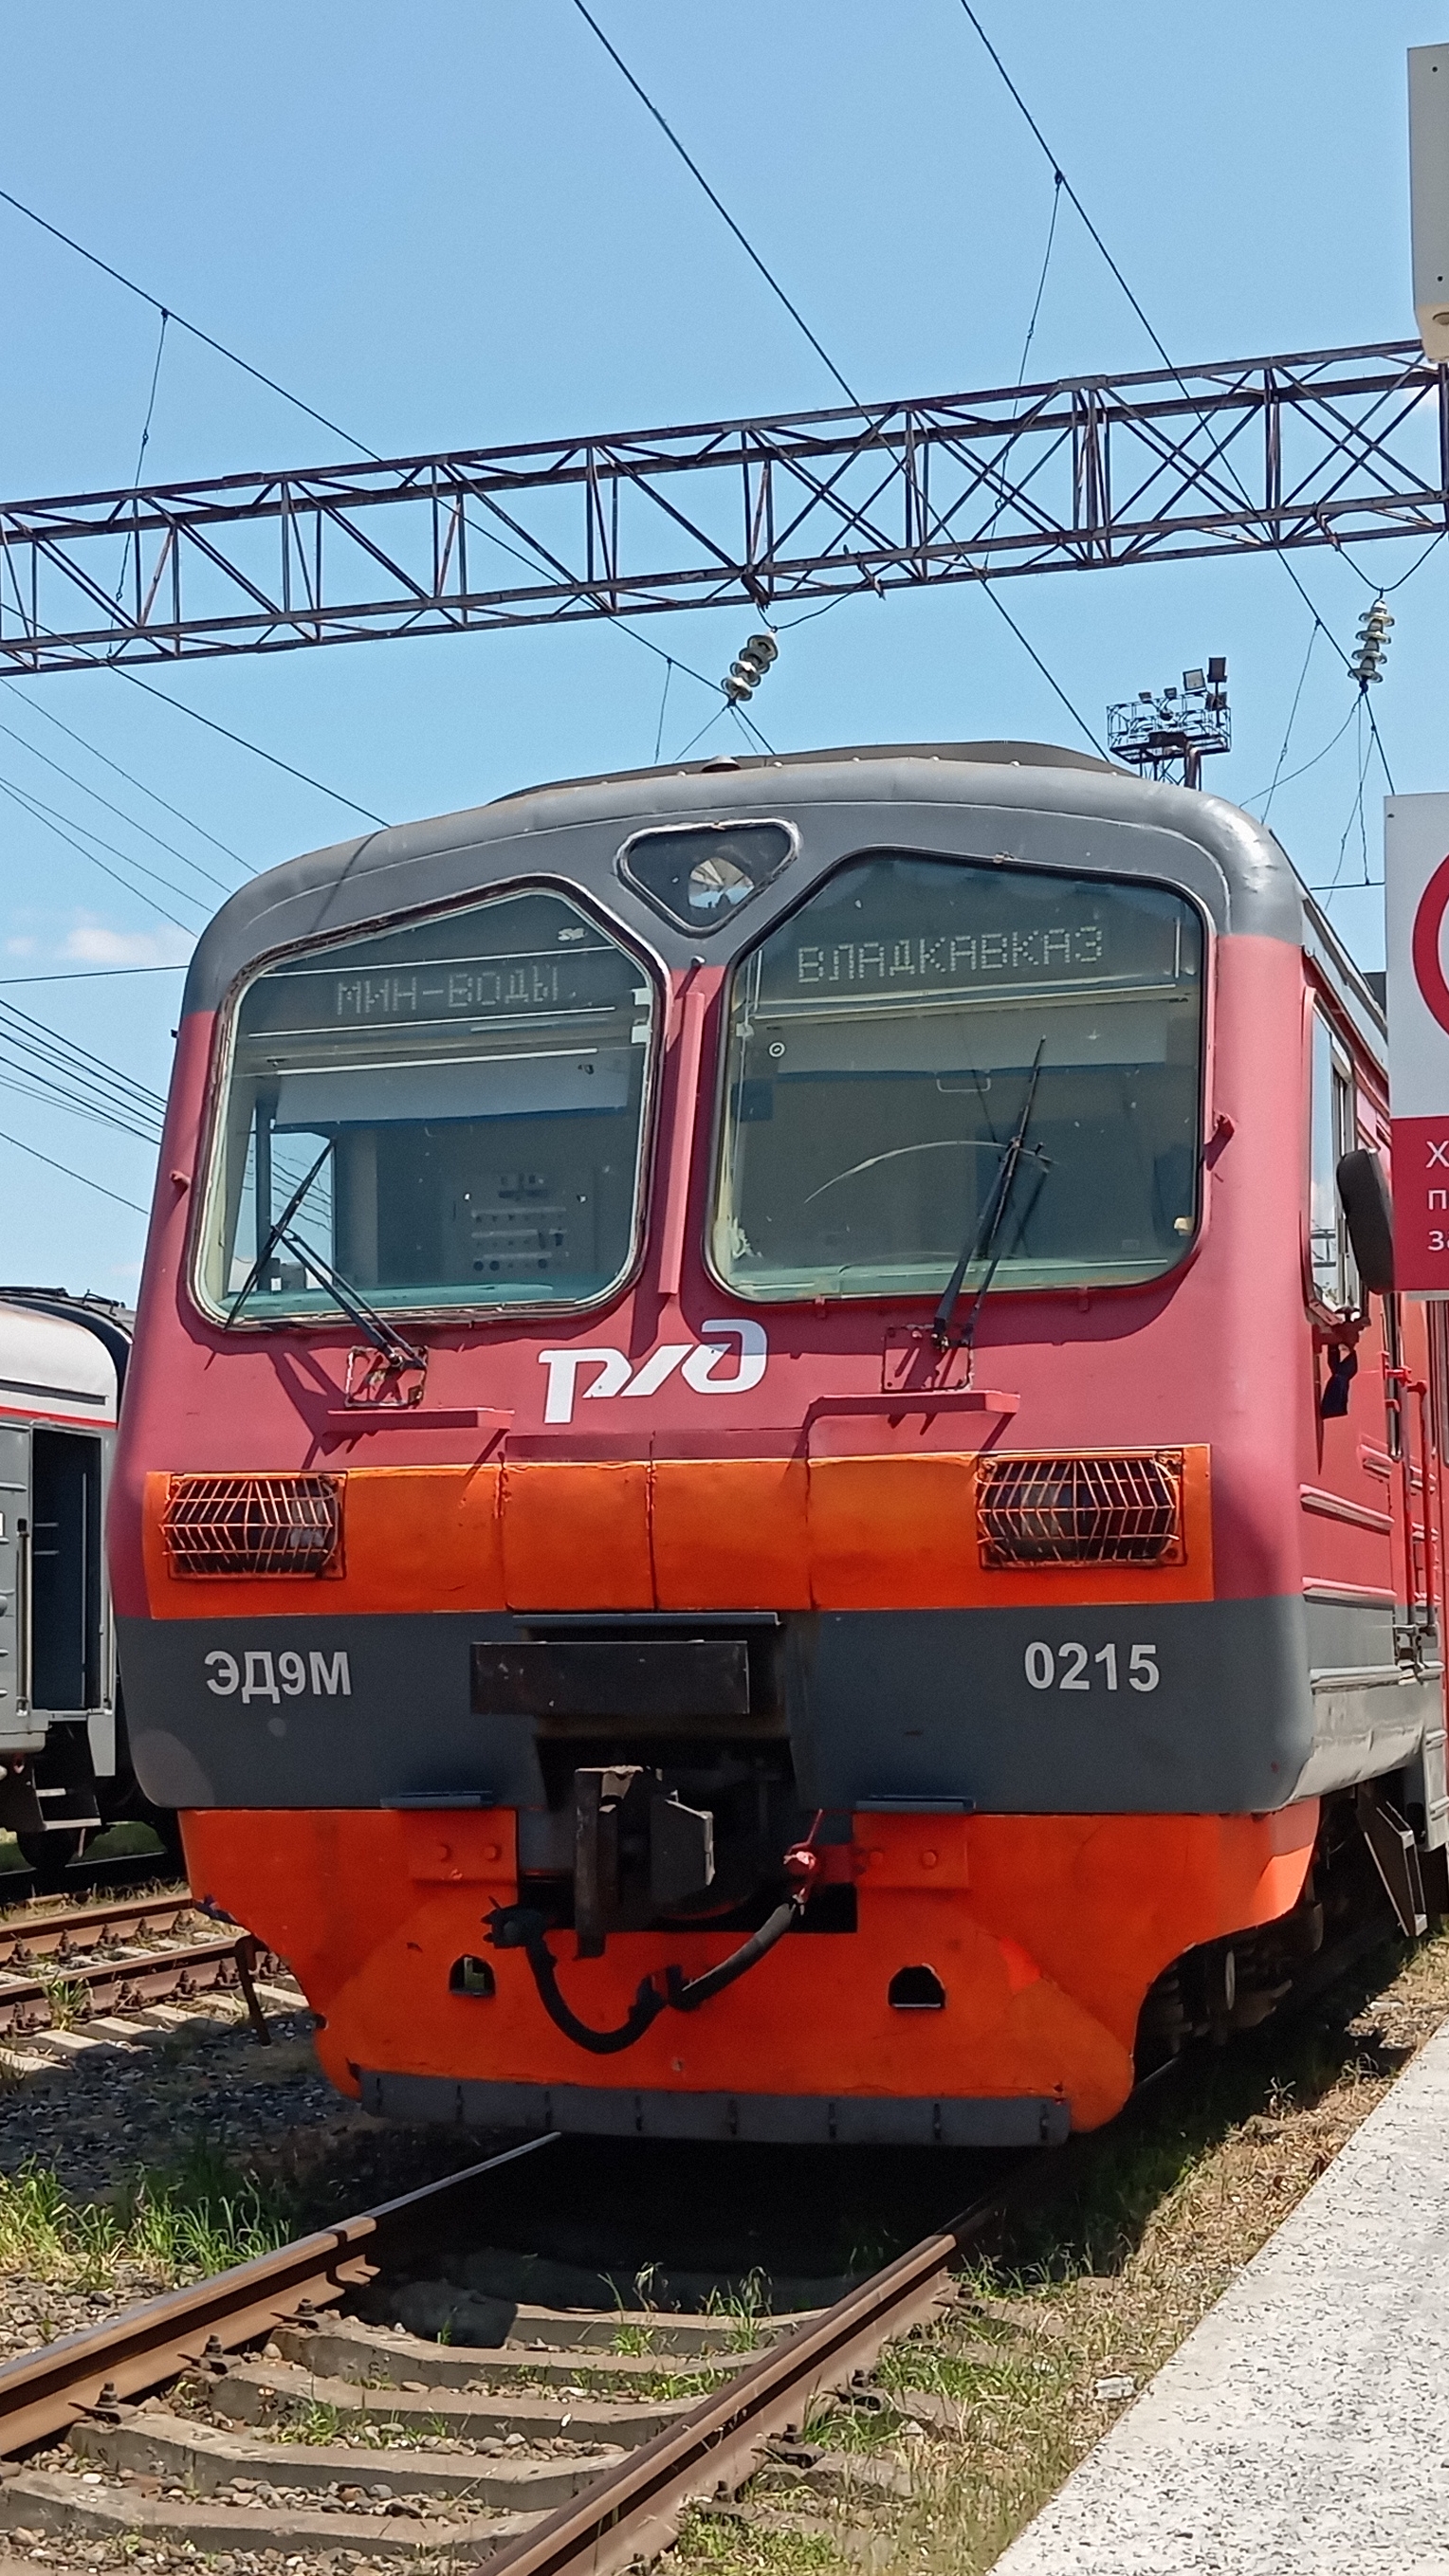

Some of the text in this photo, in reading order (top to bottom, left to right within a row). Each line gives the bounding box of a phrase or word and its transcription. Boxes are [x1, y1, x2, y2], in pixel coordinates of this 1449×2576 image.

[798, 925, 1103, 983] ВЛАДКАВКАЗ
[337, 965, 558, 1016] МИН-ВОДЫ
[204, 1651, 352, 1704] ЭД9М
[1024, 1641, 1160, 1691] 0215
